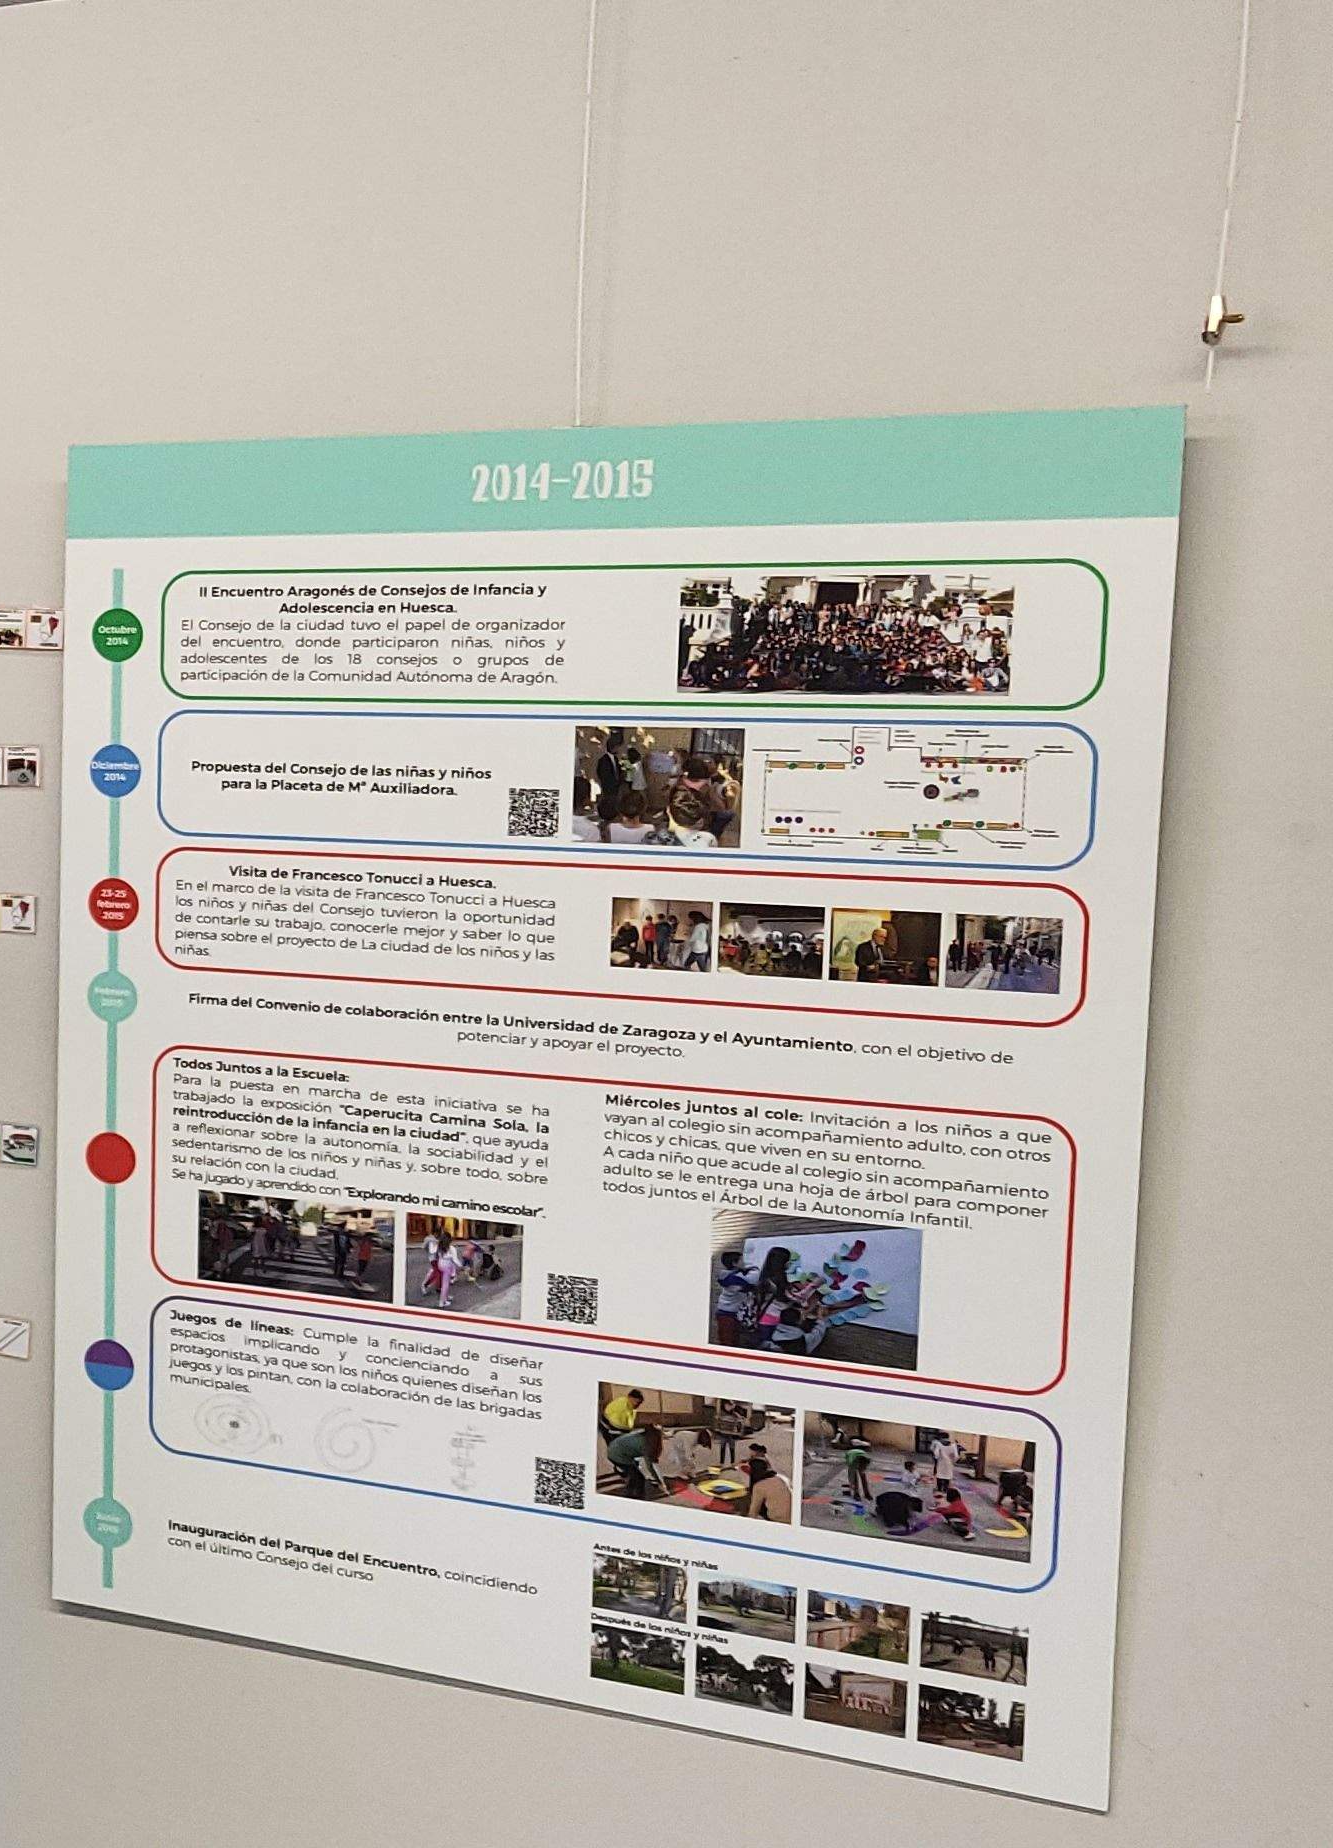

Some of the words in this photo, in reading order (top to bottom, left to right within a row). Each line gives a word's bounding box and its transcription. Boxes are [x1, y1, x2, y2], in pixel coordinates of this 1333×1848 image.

[471, 459, 654, 502] 2014-2015
[199, 586, 207, 597] II
[211, 586, 284, 597] Encuentro
[286, 584, 355, 600] Aragonés
[358, 584, 377, 596] de
[380, 583, 447, 599] Consejos
[449, 583, 469, 596] de
[473, 582, 534, 595] Infancia
[537, 585, 547, 598] y
[278, 601, 374, 614] Adolescencia
[377, 604, 396, 613] en
[399, 601, 457, 613] Huesca.
[98, 625, 137, 634] Octubre
[181, 618, 193, 631] El
[197, 619, 252, 634] Consejo
[256, 618, 275, 631] de
[279, 618, 291, 631] la
[296, 618, 345, 631] ciudad
[350, 619, 381, 631] tuvo
[386, 618, 399, 631] el
[404, 617, 446, 633] papel
[450, 617, 471, 631] de
[475, 617, 566, 633] organizador
[106, 637, 129, 646] 2014
[180, 635, 201, 648] del
[211, 637, 284, 648] encuentro,
[294, 635, 341, 648] donde
[351, 635, 439, 651] participaron
[450, 635, 493, 649] niñas,
[504, 635, 545, 649] niños
[555, 639, 566, 651] y
[180, 668, 268, 683] participación
[271, 669, 289, 681] de
[293, 669, 305, 682] la
[307, 669, 392, 682] Comunidad
[395, 670, 473, 683] Autónoma
[476, 670, 497, 683] de
[499, 670, 557, 686] Aragón.
[91, 761, 140, 771] Diciembre
[103, 773, 126, 781] 2014
[191, 760, 261, 774] Propuesta
[264, 761, 286, 774] del
[289, 763, 347, 778] Consejo
[349, 764, 368, 776] de
[371, 764, 392, 777] las
[395, 764, 435, 778] niñas
[437, 768, 447, 781] y
[450, 766, 492, 780] niños
[220, 779, 252, 791] para
[255, 778, 268, 790] la
[270, 778, 323, 792] Placeta
[325, 780, 345, 792] de
[369, 781, 458, 796] Auxiliadora.
[228, 864, 267, 878] Visita
[270, 867, 289, 879] de
[291, 868, 363, 883] Francesco
[366, 871, 423, 885] Tonucci
[425, 876, 435, 886] a
[438, 874, 496, 889] Huesca.
[96, 899, 131, 909] febrero
[175, 894, 193, 907] los
[198, 896, 235, 909] niños
[238, 900, 247, 913] y
[251, 899, 288, 912] niñas
[292, 901, 314, 913] del
[319, 902, 375, 919] Consejo
[380, 906, 438, 920] tuvieron
[444, 908, 457, 921] la
[462, 912, 556, 927] oportunidad
[188, 992, 228, 1006] Firma
[230, 995, 252, 1008] del
[255, 997, 321, 1013] Convenio
[323, 1002, 342, 1014] de
[344, 1004, 439, 1022] colaboración
[442, 1013, 483, 1025] entre
[486, 1013, 500, 1026] la
[503, 1015, 595, 1033] Universidad
[598, 1022, 619, 1035] de
[621, 1023, 696, 1041] Zaragoza
[699, 1031, 710, 1044] y
[712, 1030, 727, 1043] el
[731, 1032, 857, 1054] Ayuntamiento,
[861, 1044, 892, 1055] con
[897, 1044, 912, 1057] el
[916, 1045, 986, 1062] objetivo
[990, 1050, 1014, 1064] de
[456, 1031, 527, 1045] potenciar
[529, 1036, 539, 1049] y
[541, 1037, 593, 1052] apoyar
[596, 1039, 610, 1052] el
[614, 1043, 685, 1058] proyecto.
[172, 1056, 213, 1071] Todos
[215, 1060, 262, 1075] Juntos
[264, 1066, 273, 1076] a
[276, 1065, 289, 1077] la
[292, 1066, 350, 1083] Escuela:
[172, 1089, 236, 1105] trabajado
[242, 1094, 253, 1107] la
[260, 1098, 332, 1113] exposición
[429, 1112, 486, 1128] Camina
[536, 1121, 550, 1134] la
[605, 1093, 681, 1111] Miércoles
[684, 1099, 738, 1116] juntos
[743, 1105, 758, 1118] al
[764, 1108, 803, 1122] cole:
[810, 1111, 890, 1130] Invitación
[896, 1121, 907, 1131] a
[915, 1119, 938, 1134] los
[945, 1123, 992, 1139] niños
[999, 1130, 1009, 1140] a
[1016, 1131, 1052, 1145] que
[603, 1113, 647, 1127] vayan
[651, 1115, 665, 1127] al
[667, 1117, 726, 1134] colegio
[728, 1121, 751, 1135] sin
[754, 1126, 903, 1149] acompañamiento
[906, 1138, 966, 1156] adulto,
[969, 1145, 1002, 1158] con
[1005, 1148, 1051, 1163] otros
[169, 1308, 217, 1326] Juegos
[224, 1316, 243, 1329] de
[250, 1319, 294, 1337] líneas:
[302, 1327, 358, 1345] Cumple
[367, 1335, 379, 1348] la
[389, 1338, 451, 1357] finalidad
[460, 1348, 480, 1362] de
[489, 1353, 543, 1370] diseñar
[168, 1519, 256, 1545] Inauguración
[259, 1535, 281, 1549] del
[284, 1539, 334, 1558] Parque
[336, 1549, 359, 1563] del
[362, 1553, 441, 1579] Encuentro,
[443, 1570, 538, 1595] coincidiendo
[592, 1543, 622, 1555] Antes
[622, 1548, 637, 1556] de
[637, 1550, 652, 1560] los
[653, 1553, 681, 1565] niños
[690, 1560, 719, 1571] niñas
